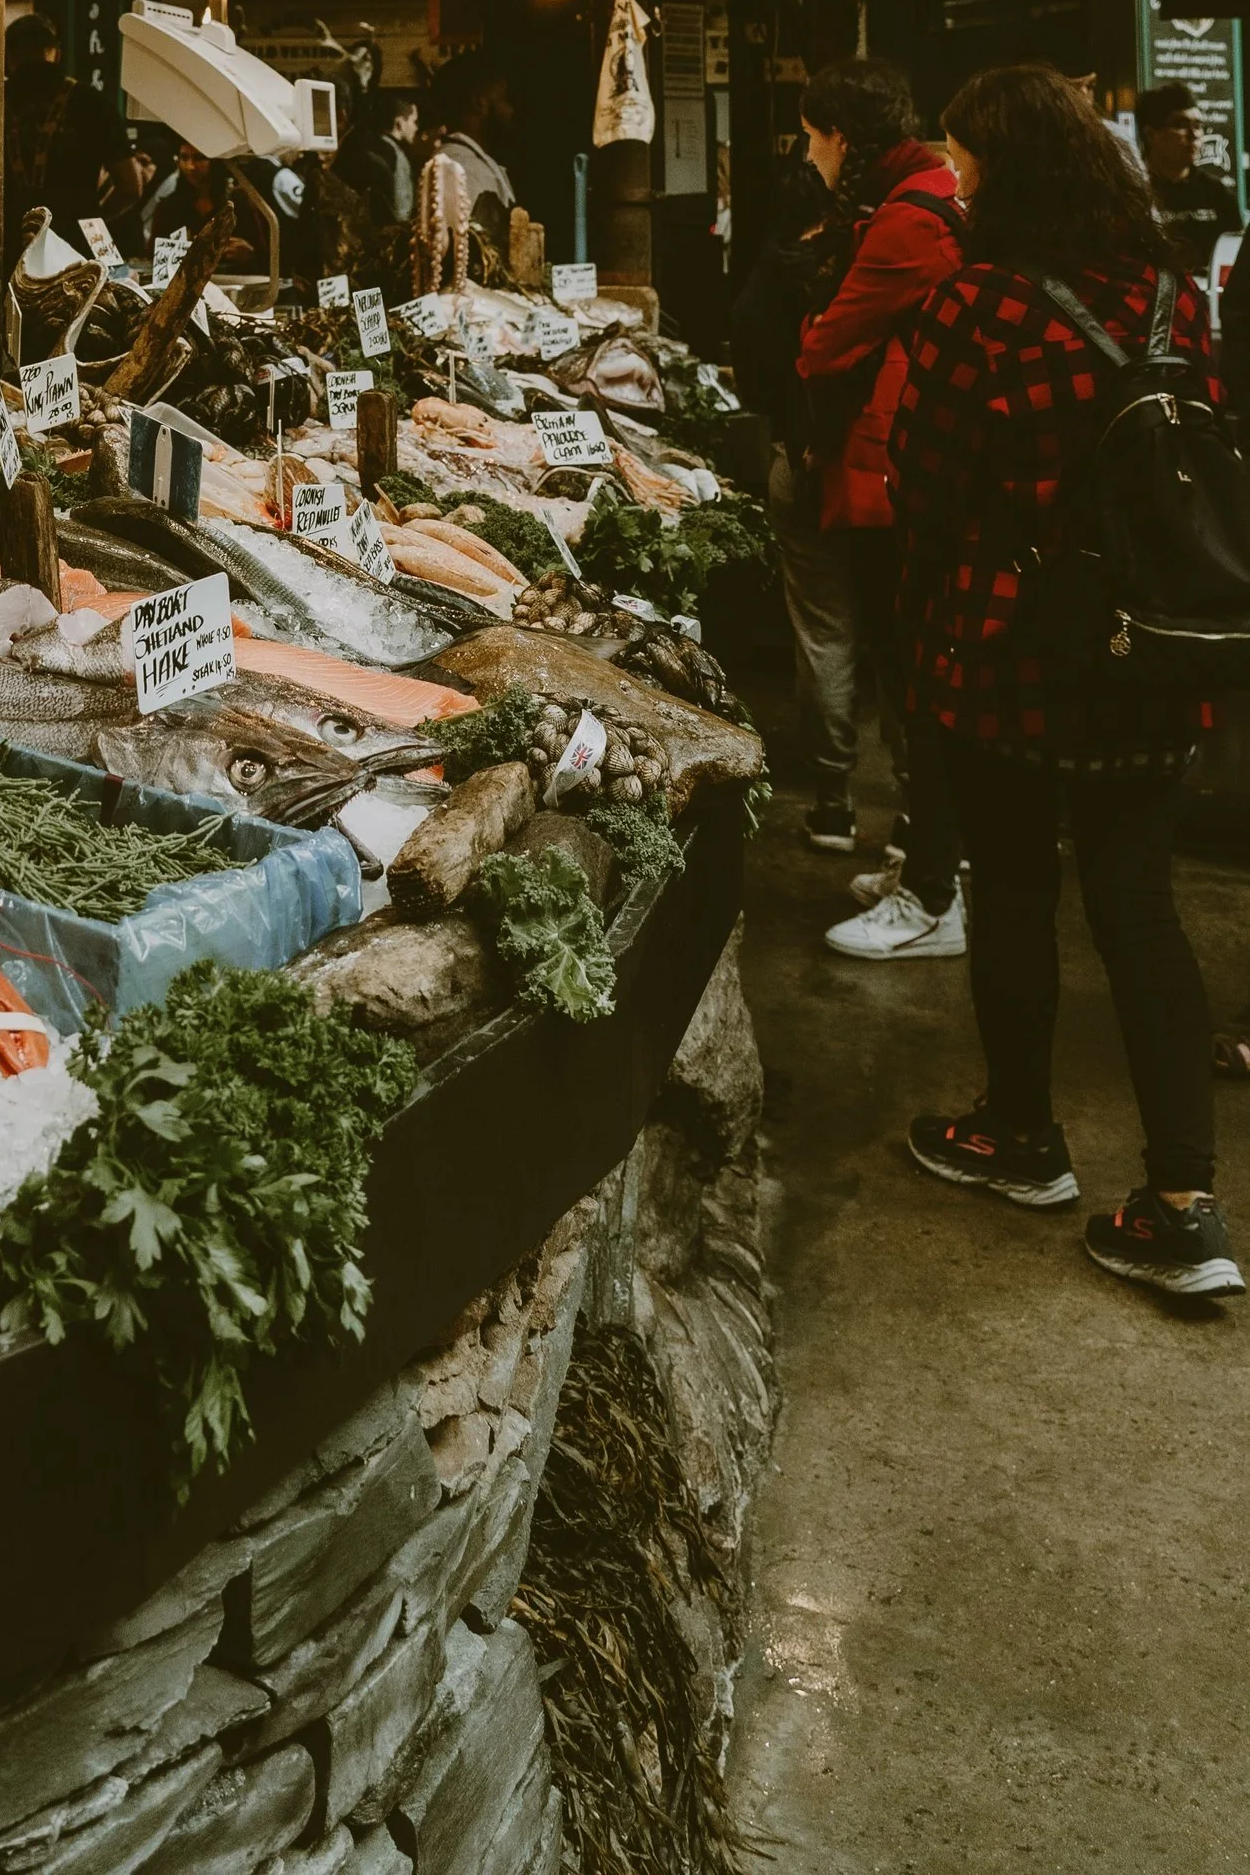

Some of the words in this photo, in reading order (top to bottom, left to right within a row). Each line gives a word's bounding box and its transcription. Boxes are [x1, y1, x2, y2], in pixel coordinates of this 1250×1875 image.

[45, 371, 75, 406] PRAWN
[553, 445, 582, 459] CLAM
[295, 487, 326, 508] CORNISH
[296, 511, 316, 533] RED
[315, 506, 342, 528] MULLET
[133, 599, 157, 633] DAY
[156, 585, 195, 626] BOAT
[135, 615, 204, 659] SHETLAND
[142, 639, 191, 695] HAKE
[192, 660, 214, 682] STEAK
